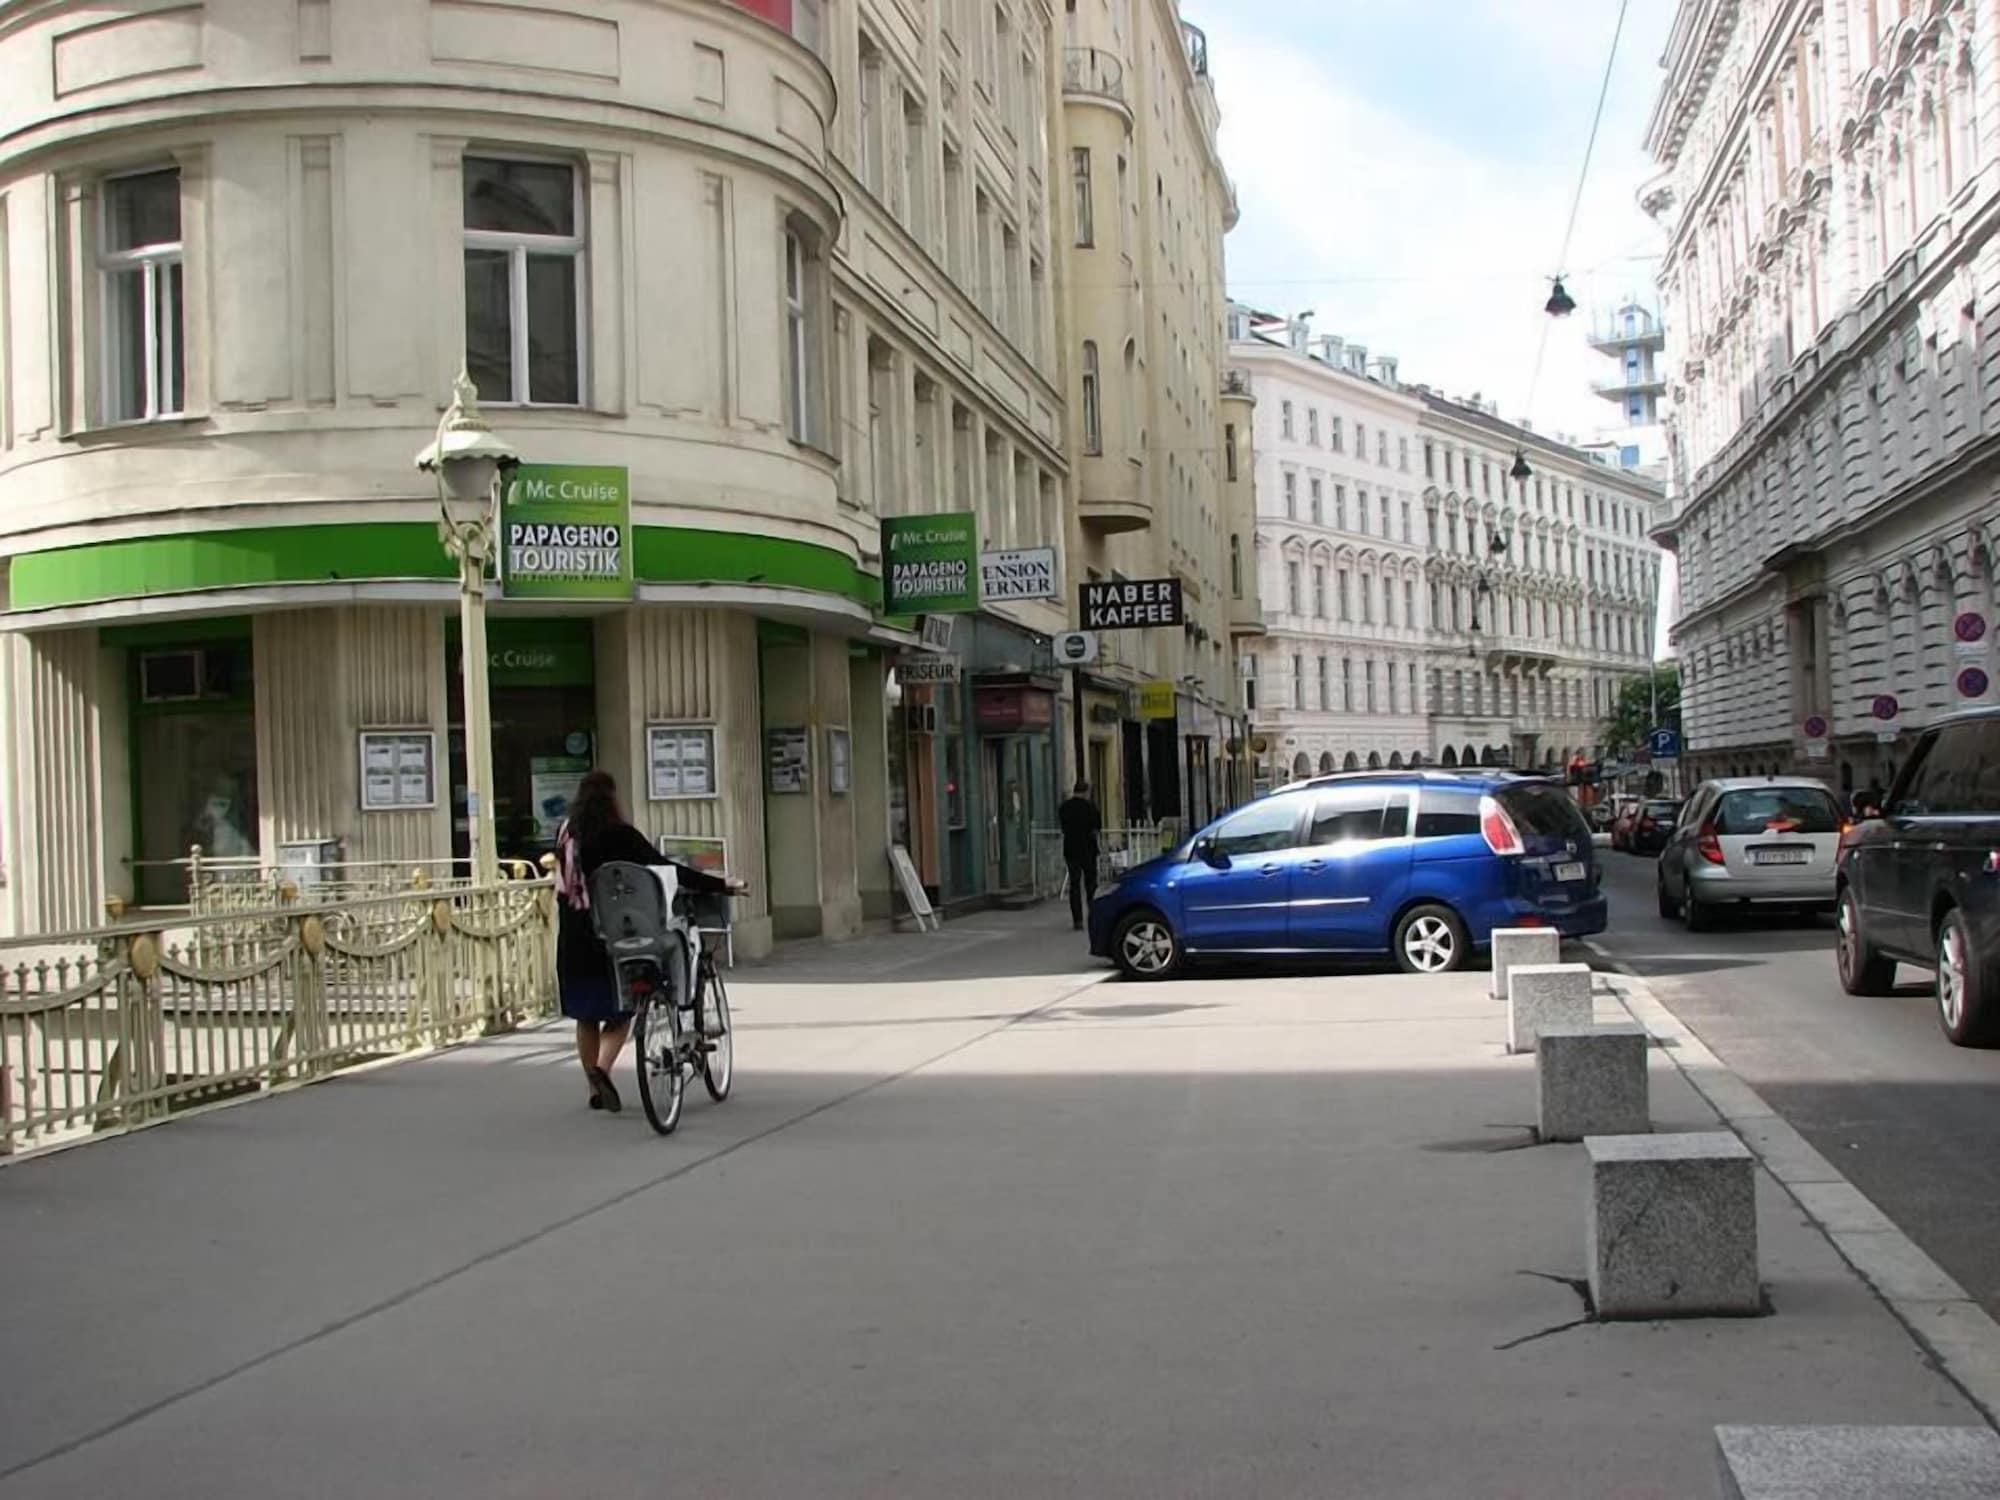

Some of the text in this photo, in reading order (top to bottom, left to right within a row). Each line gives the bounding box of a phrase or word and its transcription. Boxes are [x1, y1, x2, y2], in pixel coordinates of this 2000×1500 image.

[526, 479, 619, 501] Mc Cruise
[510, 525, 619, 546] PAPAGENO
[903, 528, 967, 545] Mc Cruise
[512, 549, 619, 572] TOURISTIK
[893, 560, 967, 578] PAPAGENO
[983, 561, 1050, 580] ENSION
[893, 576, 967, 594] TOURISTIK
[984, 577, 1051, 596] ERNER
[1088, 583, 1172, 605] NABER
[1089, 604, 1174, 626] KAFFEE
[503, 650, 555, 667] Cruise
[897, 664, 955, 681] FRISEUR
[1657, 732, 1671, 748] P
